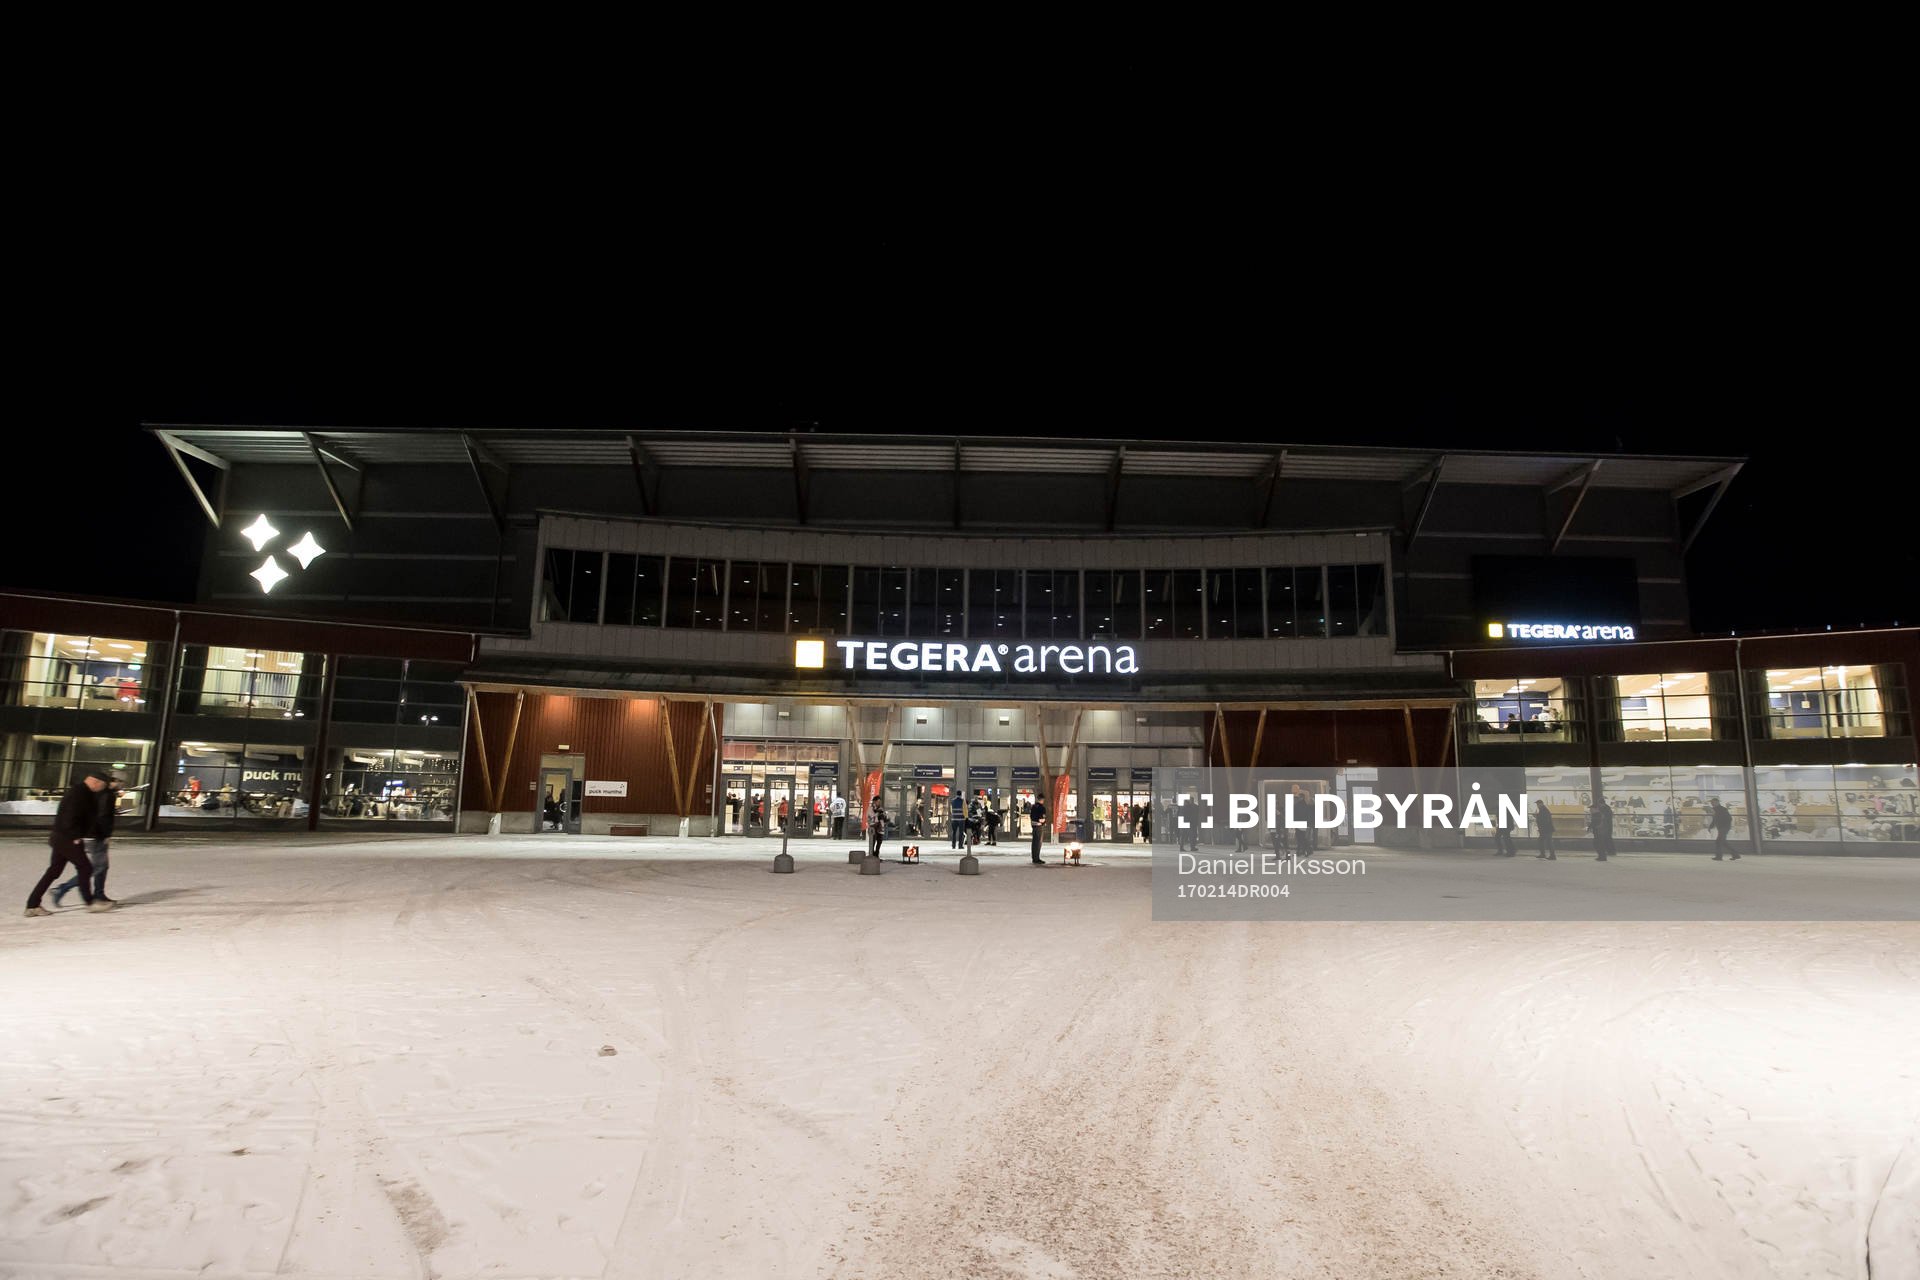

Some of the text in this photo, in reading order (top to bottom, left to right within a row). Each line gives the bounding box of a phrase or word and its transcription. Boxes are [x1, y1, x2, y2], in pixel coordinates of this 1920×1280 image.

[1582, 625, 1635, 640] arena
[1014, 644, 1139, 674] arena
[243, 769, 280, 782] puck
